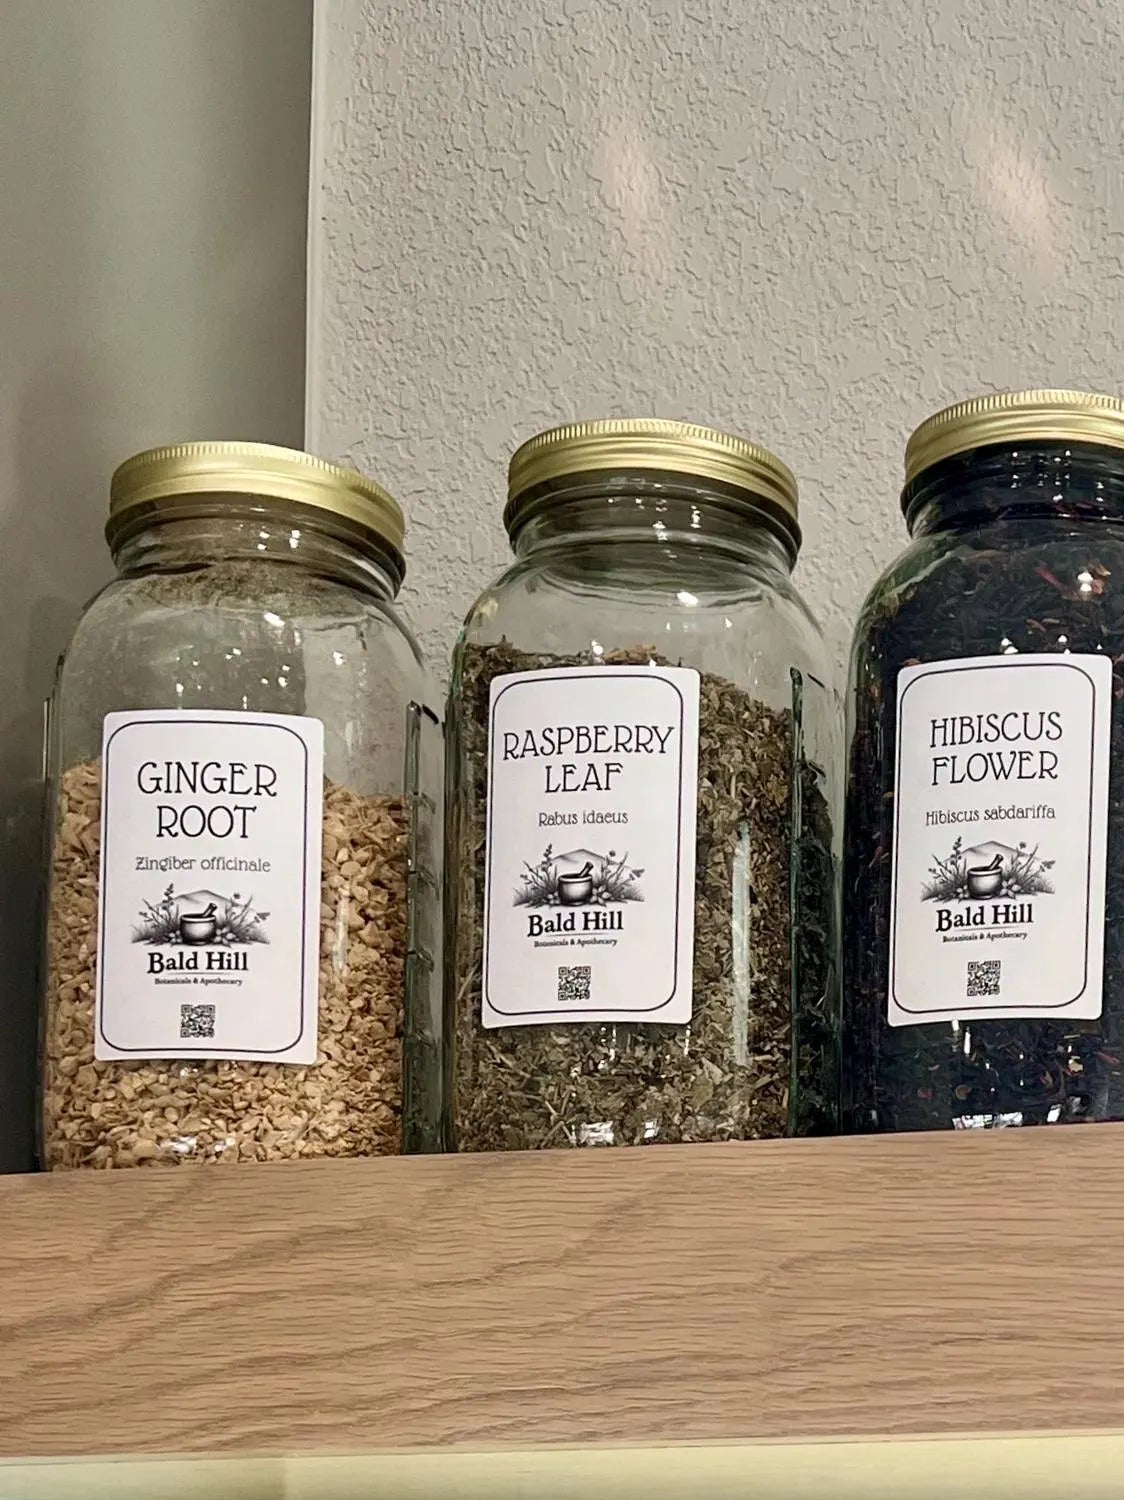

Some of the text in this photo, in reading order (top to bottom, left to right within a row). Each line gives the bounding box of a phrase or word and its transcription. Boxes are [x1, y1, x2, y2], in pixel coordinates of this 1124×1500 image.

[503, 725, 674, 760] RASPBERRY
[929, 711, 1063, 748] HIBISCUS
[137, 761, 278, 797] GINGER
[544, 762, 624, 793] LEAF
[931, 750, 1058, 786] FLOWER
[156, 804, 257, 839] ROOT
[582, 809, 629, 825] idaeus
[926, 804, 1056, 826] Hibiscus sabdariffa
[135, 856, 271, 873] Zingiber officinale
[527, 911, 624, 938] Bald Hill
[935, 903, 1033, 933] Bald Hill
[147, 951, 248, 974] Bald Hill
